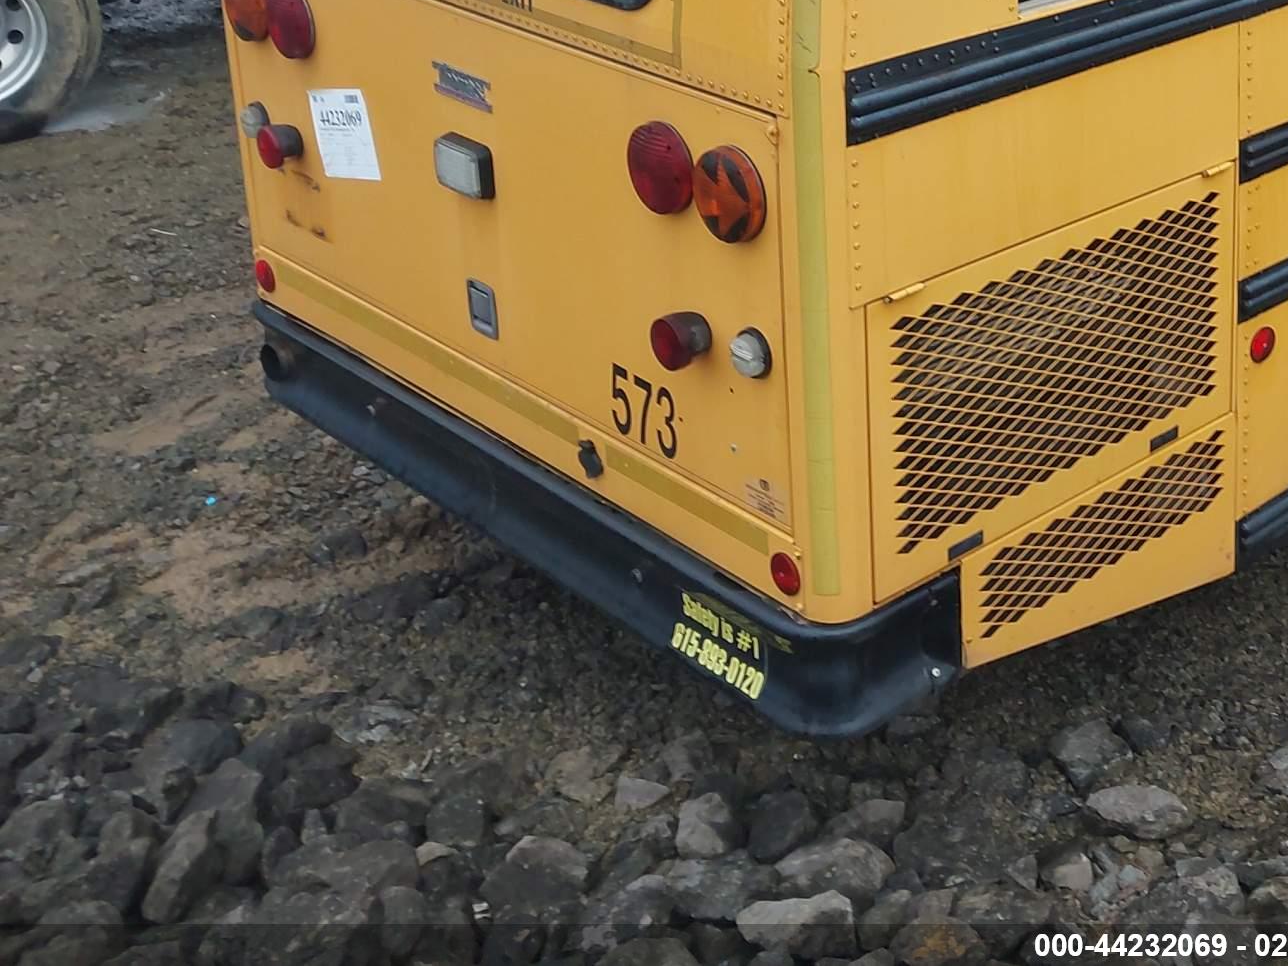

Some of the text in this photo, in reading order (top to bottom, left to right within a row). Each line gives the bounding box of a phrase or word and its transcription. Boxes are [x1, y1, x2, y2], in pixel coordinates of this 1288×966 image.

[319, 108, 363, 128] 44232069
[611, 362, 678, 460] 573
[671, 621, 765, 700] 615-893-0120
[682, 592, 760, 660] Safety is #1
